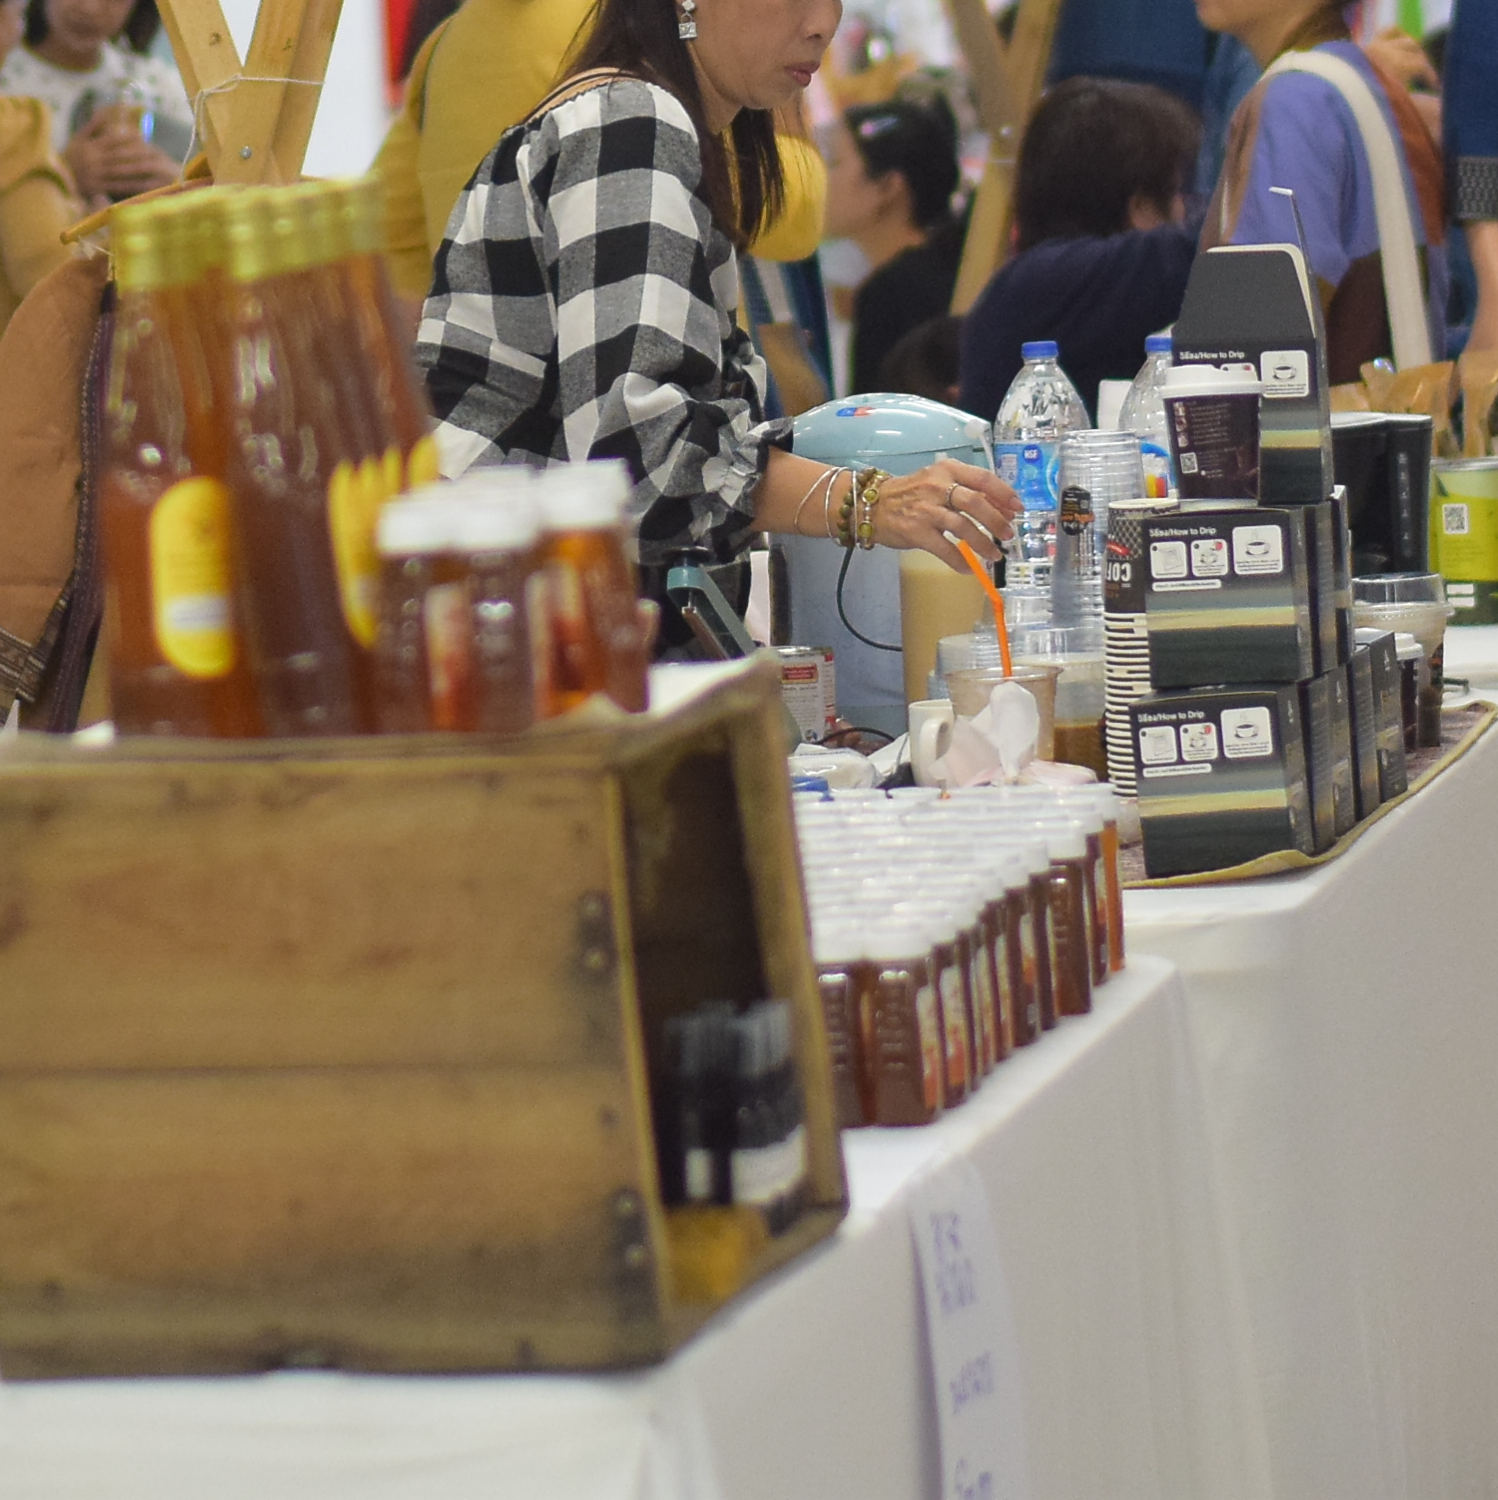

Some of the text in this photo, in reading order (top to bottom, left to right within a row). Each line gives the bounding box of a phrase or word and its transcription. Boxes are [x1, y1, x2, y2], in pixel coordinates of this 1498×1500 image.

[1228, 350, 1245, 359] Drip
[1199, 526, 1216, 535] Drip
[1187, 710, 1205, 720] Drip
